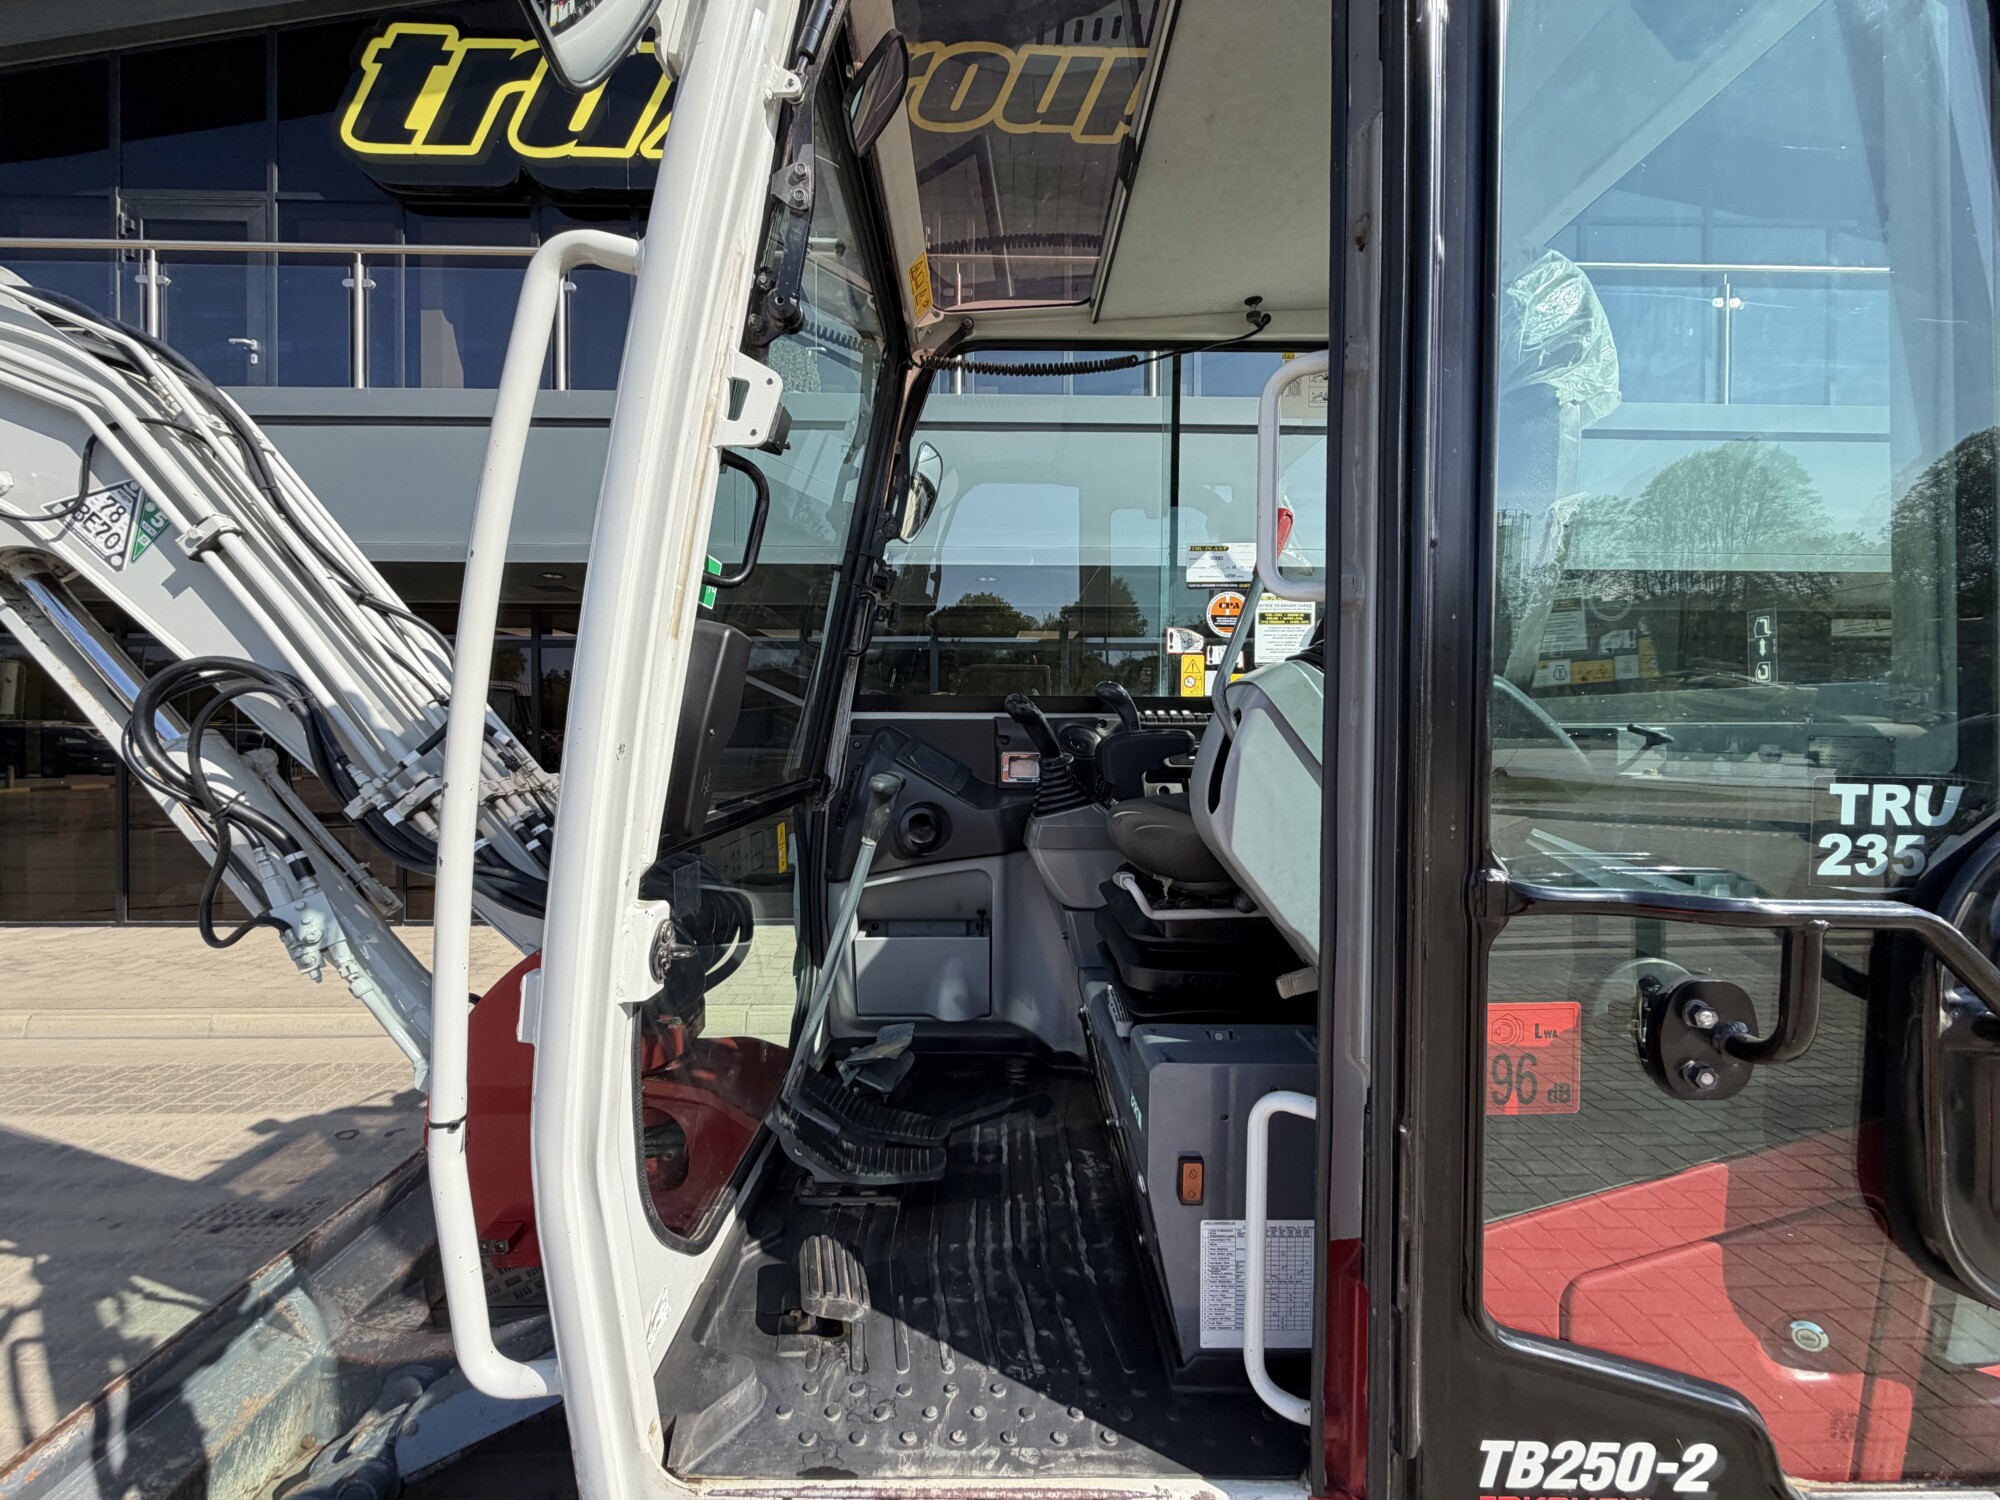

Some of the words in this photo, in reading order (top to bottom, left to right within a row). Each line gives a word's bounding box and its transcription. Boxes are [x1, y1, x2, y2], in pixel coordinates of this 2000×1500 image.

[341, 22, 672, 158] tru
[99, 495, 127, 524] 78
[150, 510, 169, 528] 5
[1829, 783, 1965, 827] TRU
[1491, 1053, 1538, 1105] 96
[1547, 1082, 1571, 1104] dB
[1479, 1440, 1718, 1492] TB250-2
